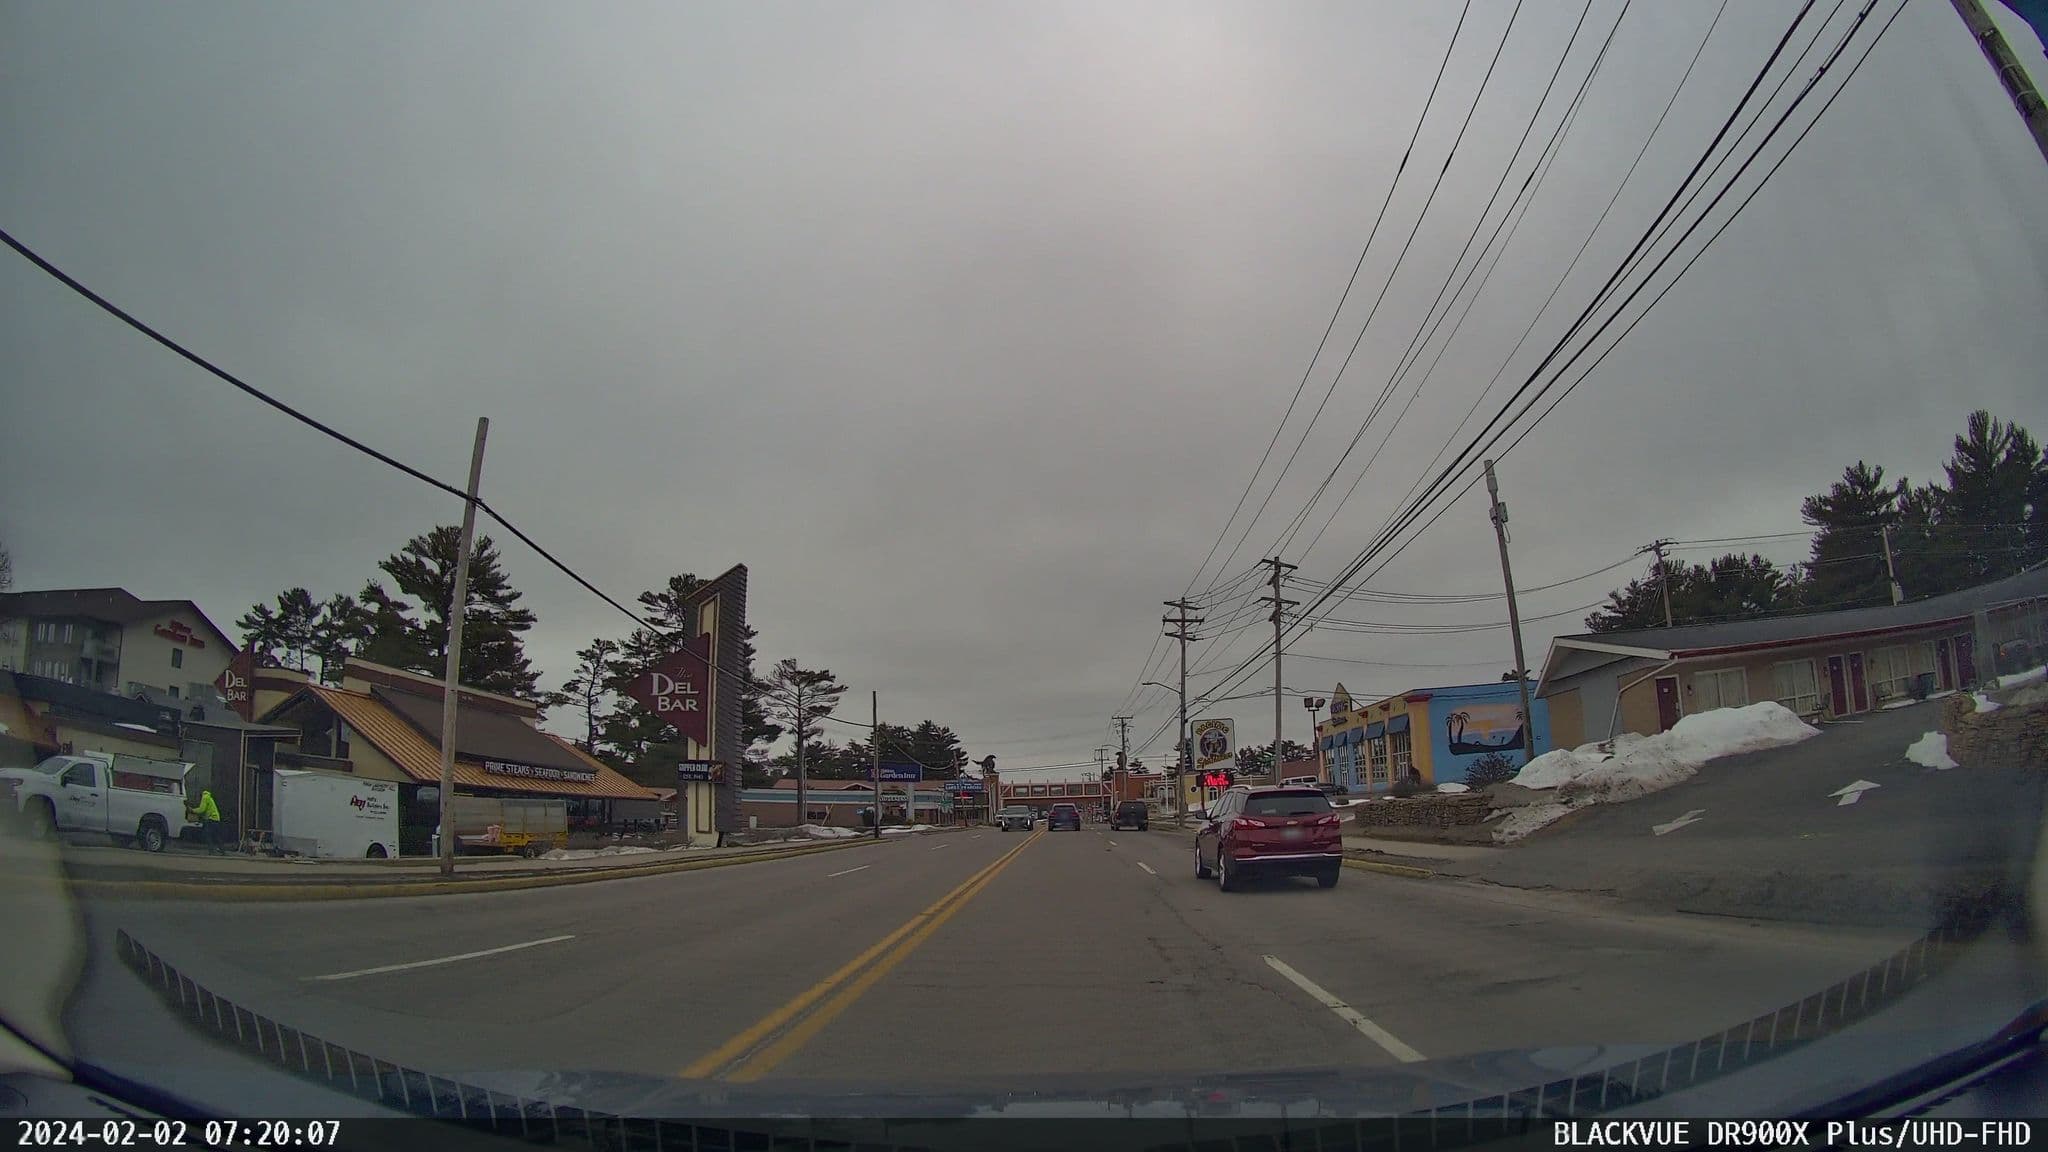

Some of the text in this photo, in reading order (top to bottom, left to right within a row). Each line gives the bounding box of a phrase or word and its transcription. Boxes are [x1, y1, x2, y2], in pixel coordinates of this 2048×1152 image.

[225, 669, 248, 688] DEL
[650, 672, 699, 696] DEL
[227, 689, 247, 701] BAR
[658, 696, 699, 711] BAR
[485, 761, 596, 782] PRIME STEAKS SEAFOOD SANDWICHES
